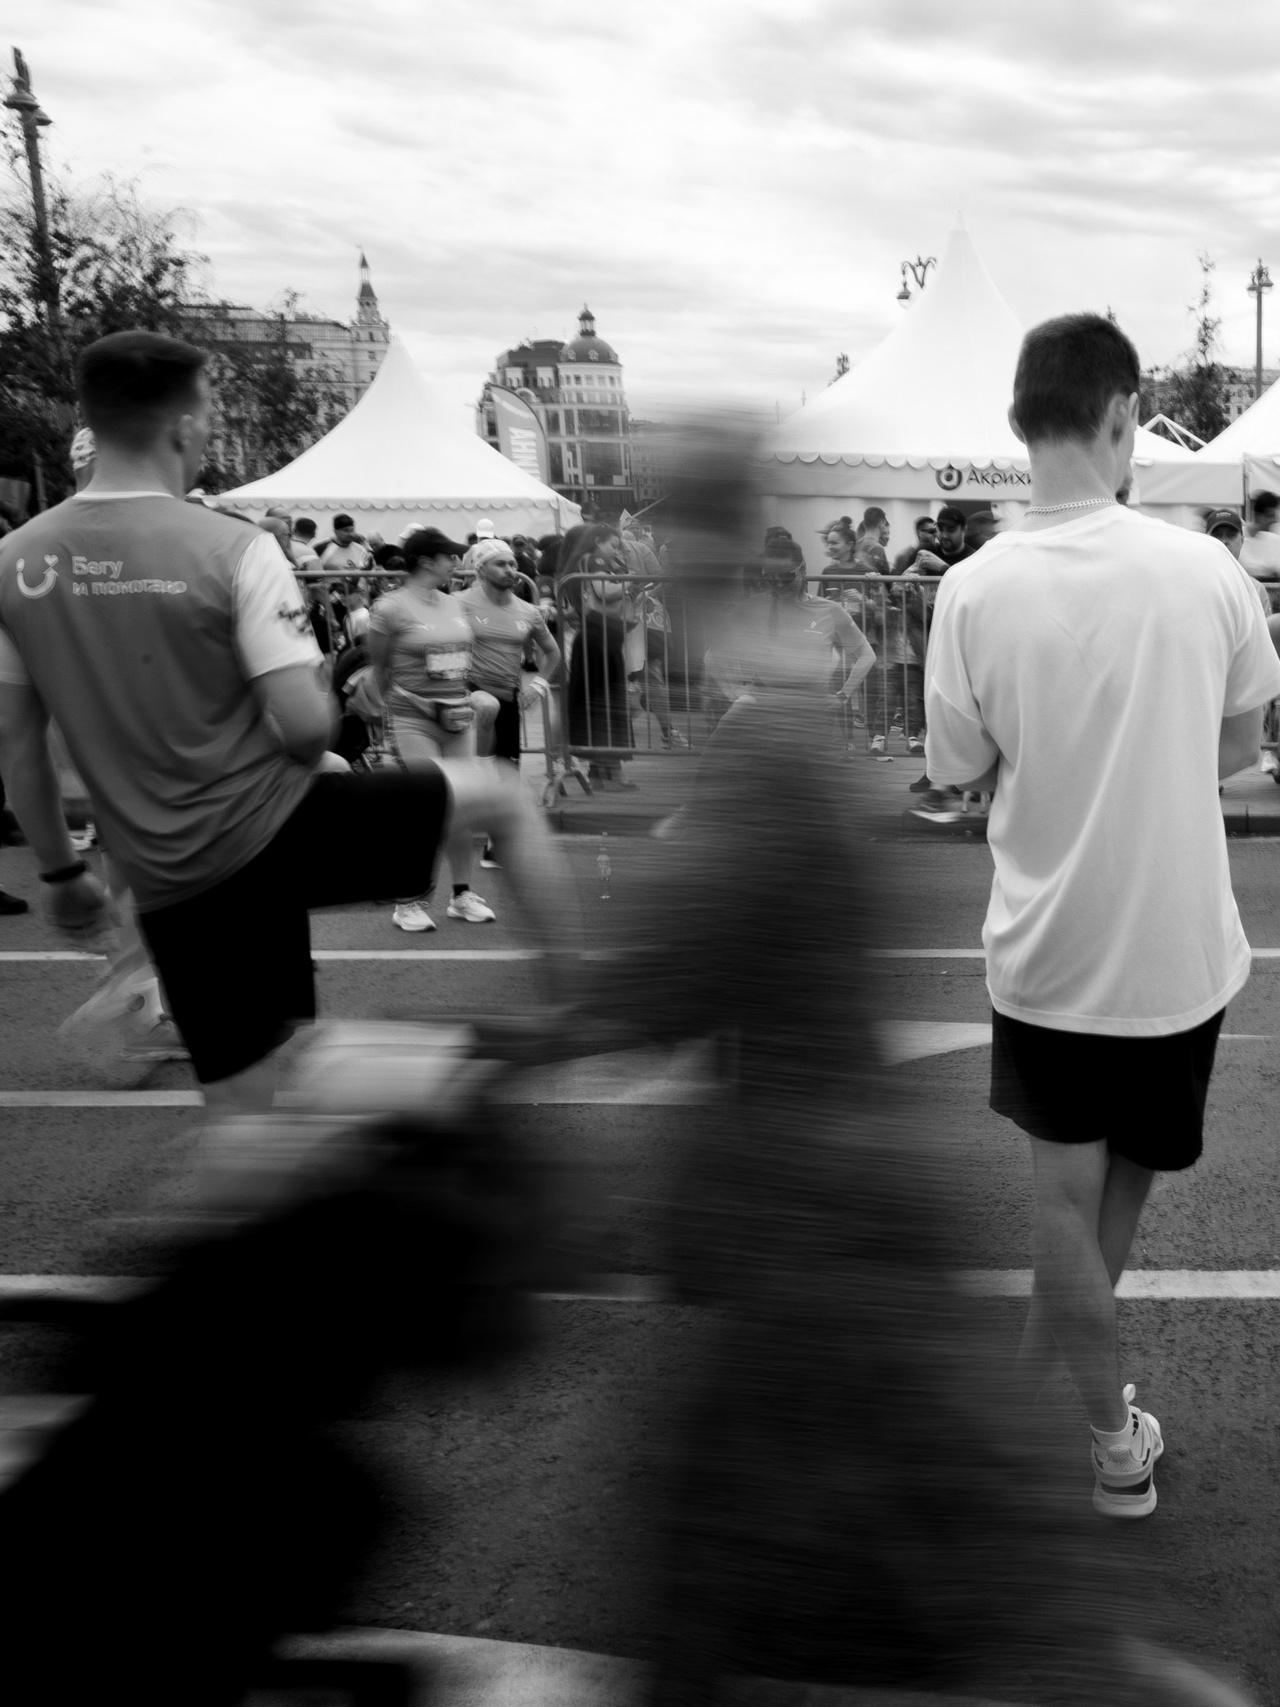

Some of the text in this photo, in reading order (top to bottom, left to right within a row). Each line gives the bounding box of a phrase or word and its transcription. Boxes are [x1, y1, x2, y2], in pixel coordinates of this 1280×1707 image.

[72, 556, 124, 579] Бегу
[72, 579, 187, 596] и помогаю
